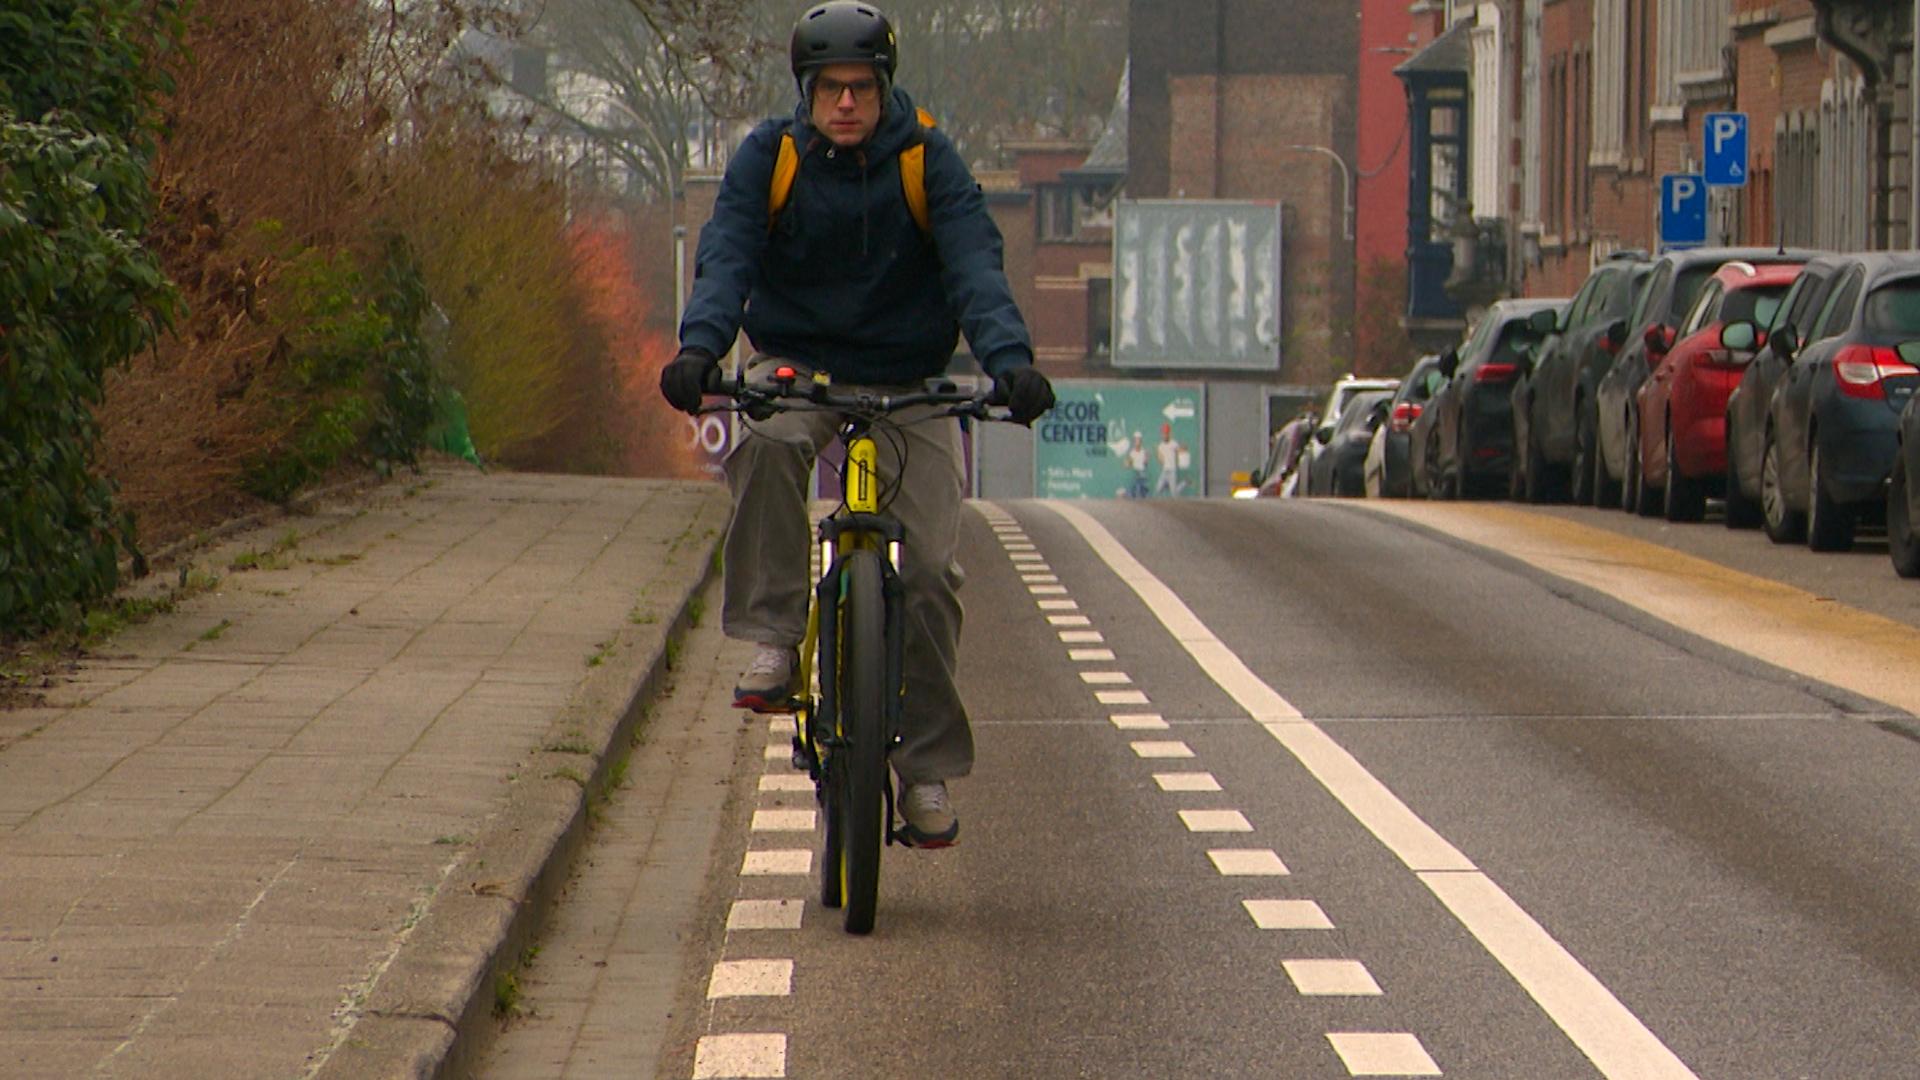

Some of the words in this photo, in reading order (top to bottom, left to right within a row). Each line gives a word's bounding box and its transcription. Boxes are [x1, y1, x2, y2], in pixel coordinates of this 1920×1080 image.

[1714, 117, 1737, 154] P
[1672, 178, 1696, 214] P
[1041, 424, 1107, 442] CENTER
